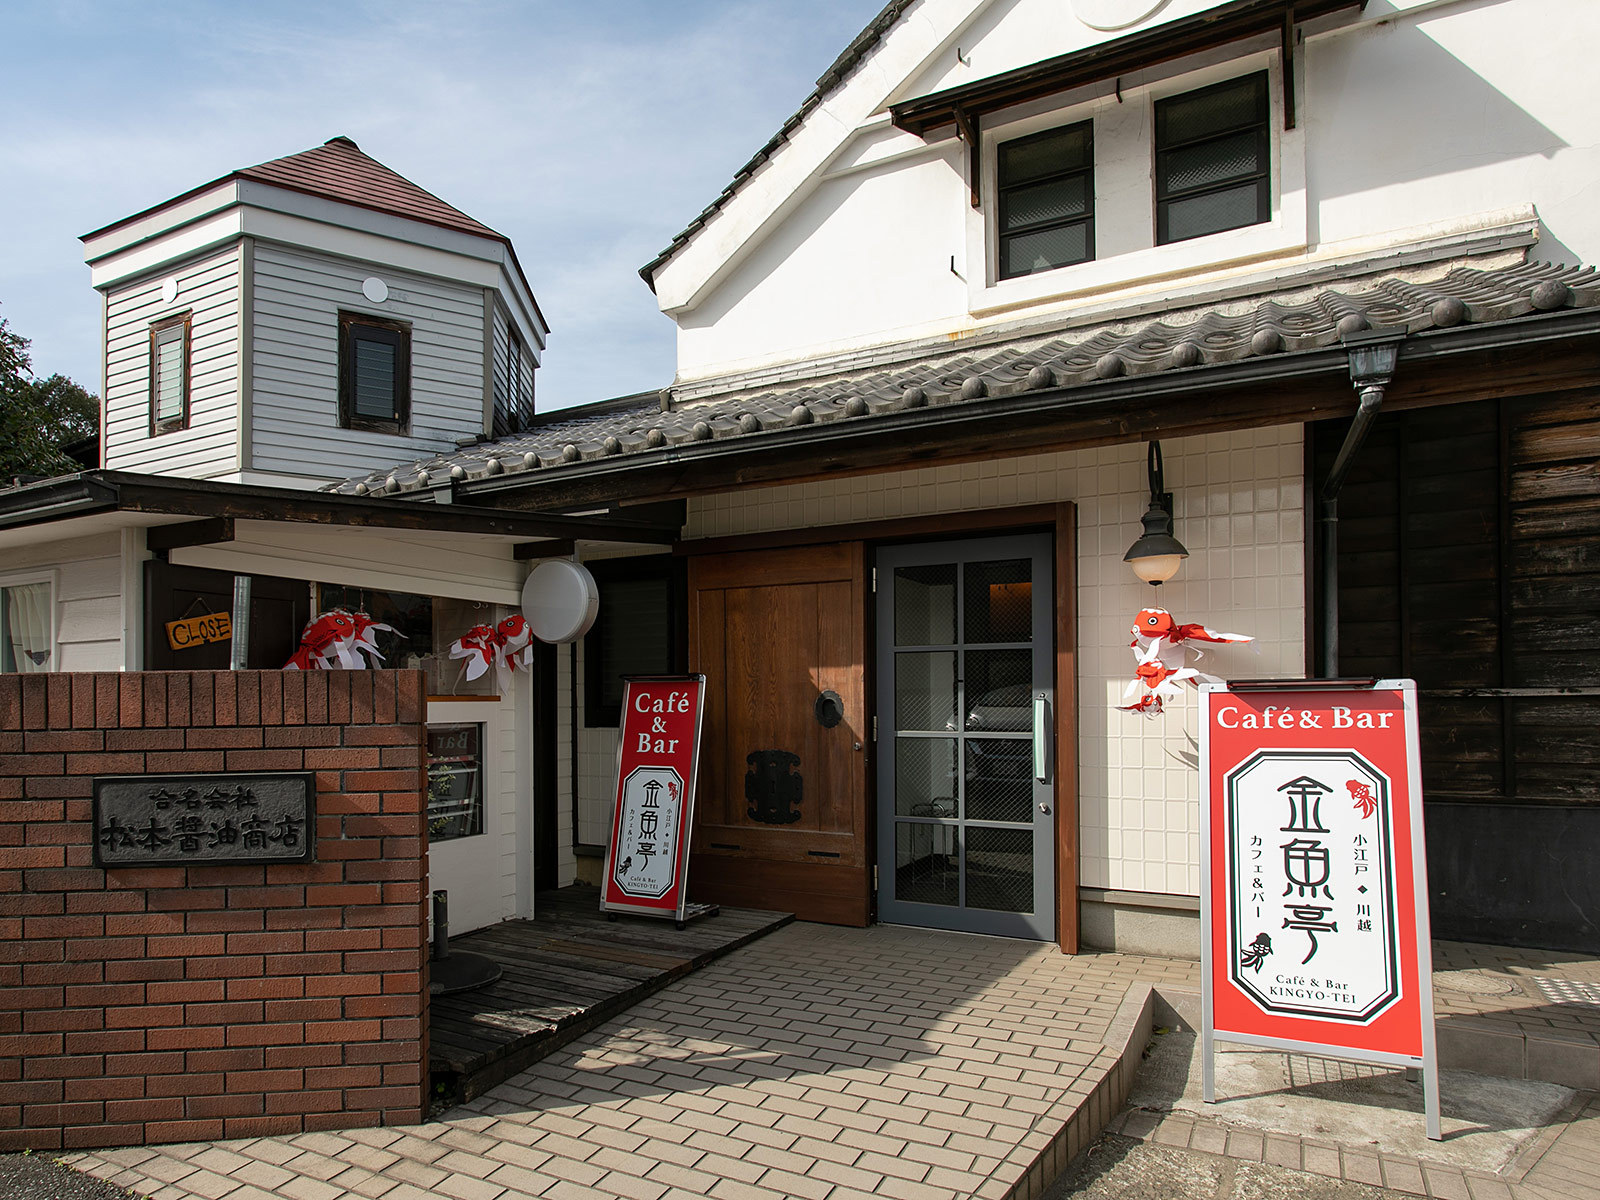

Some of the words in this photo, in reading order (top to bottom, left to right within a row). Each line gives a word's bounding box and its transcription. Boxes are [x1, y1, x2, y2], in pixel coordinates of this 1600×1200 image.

[172, 617, 230, 645] CLOSE
[635, 692, 690, 713] Café
[651, 716, 667, 733] &
[1331, 706, 1394, 729] Bar
[636, 733, 680, 754] Bar
[149, 786, 259, 810] 合名会社
[635, 779, 664, 872] 金魚亭
[1353, 834, 1368, 876] 小江戸
[1277, 776, 1338, 965] 金魚亭
[1357, 903, 1372, 932] 川越
[1276, 974, 1305, 986] Café
[1310, 978, 1320, 988] &
[1326, 979, 1348, 990] Bar
[1270, 986, 1356, 1004] KINGYO-TEI
